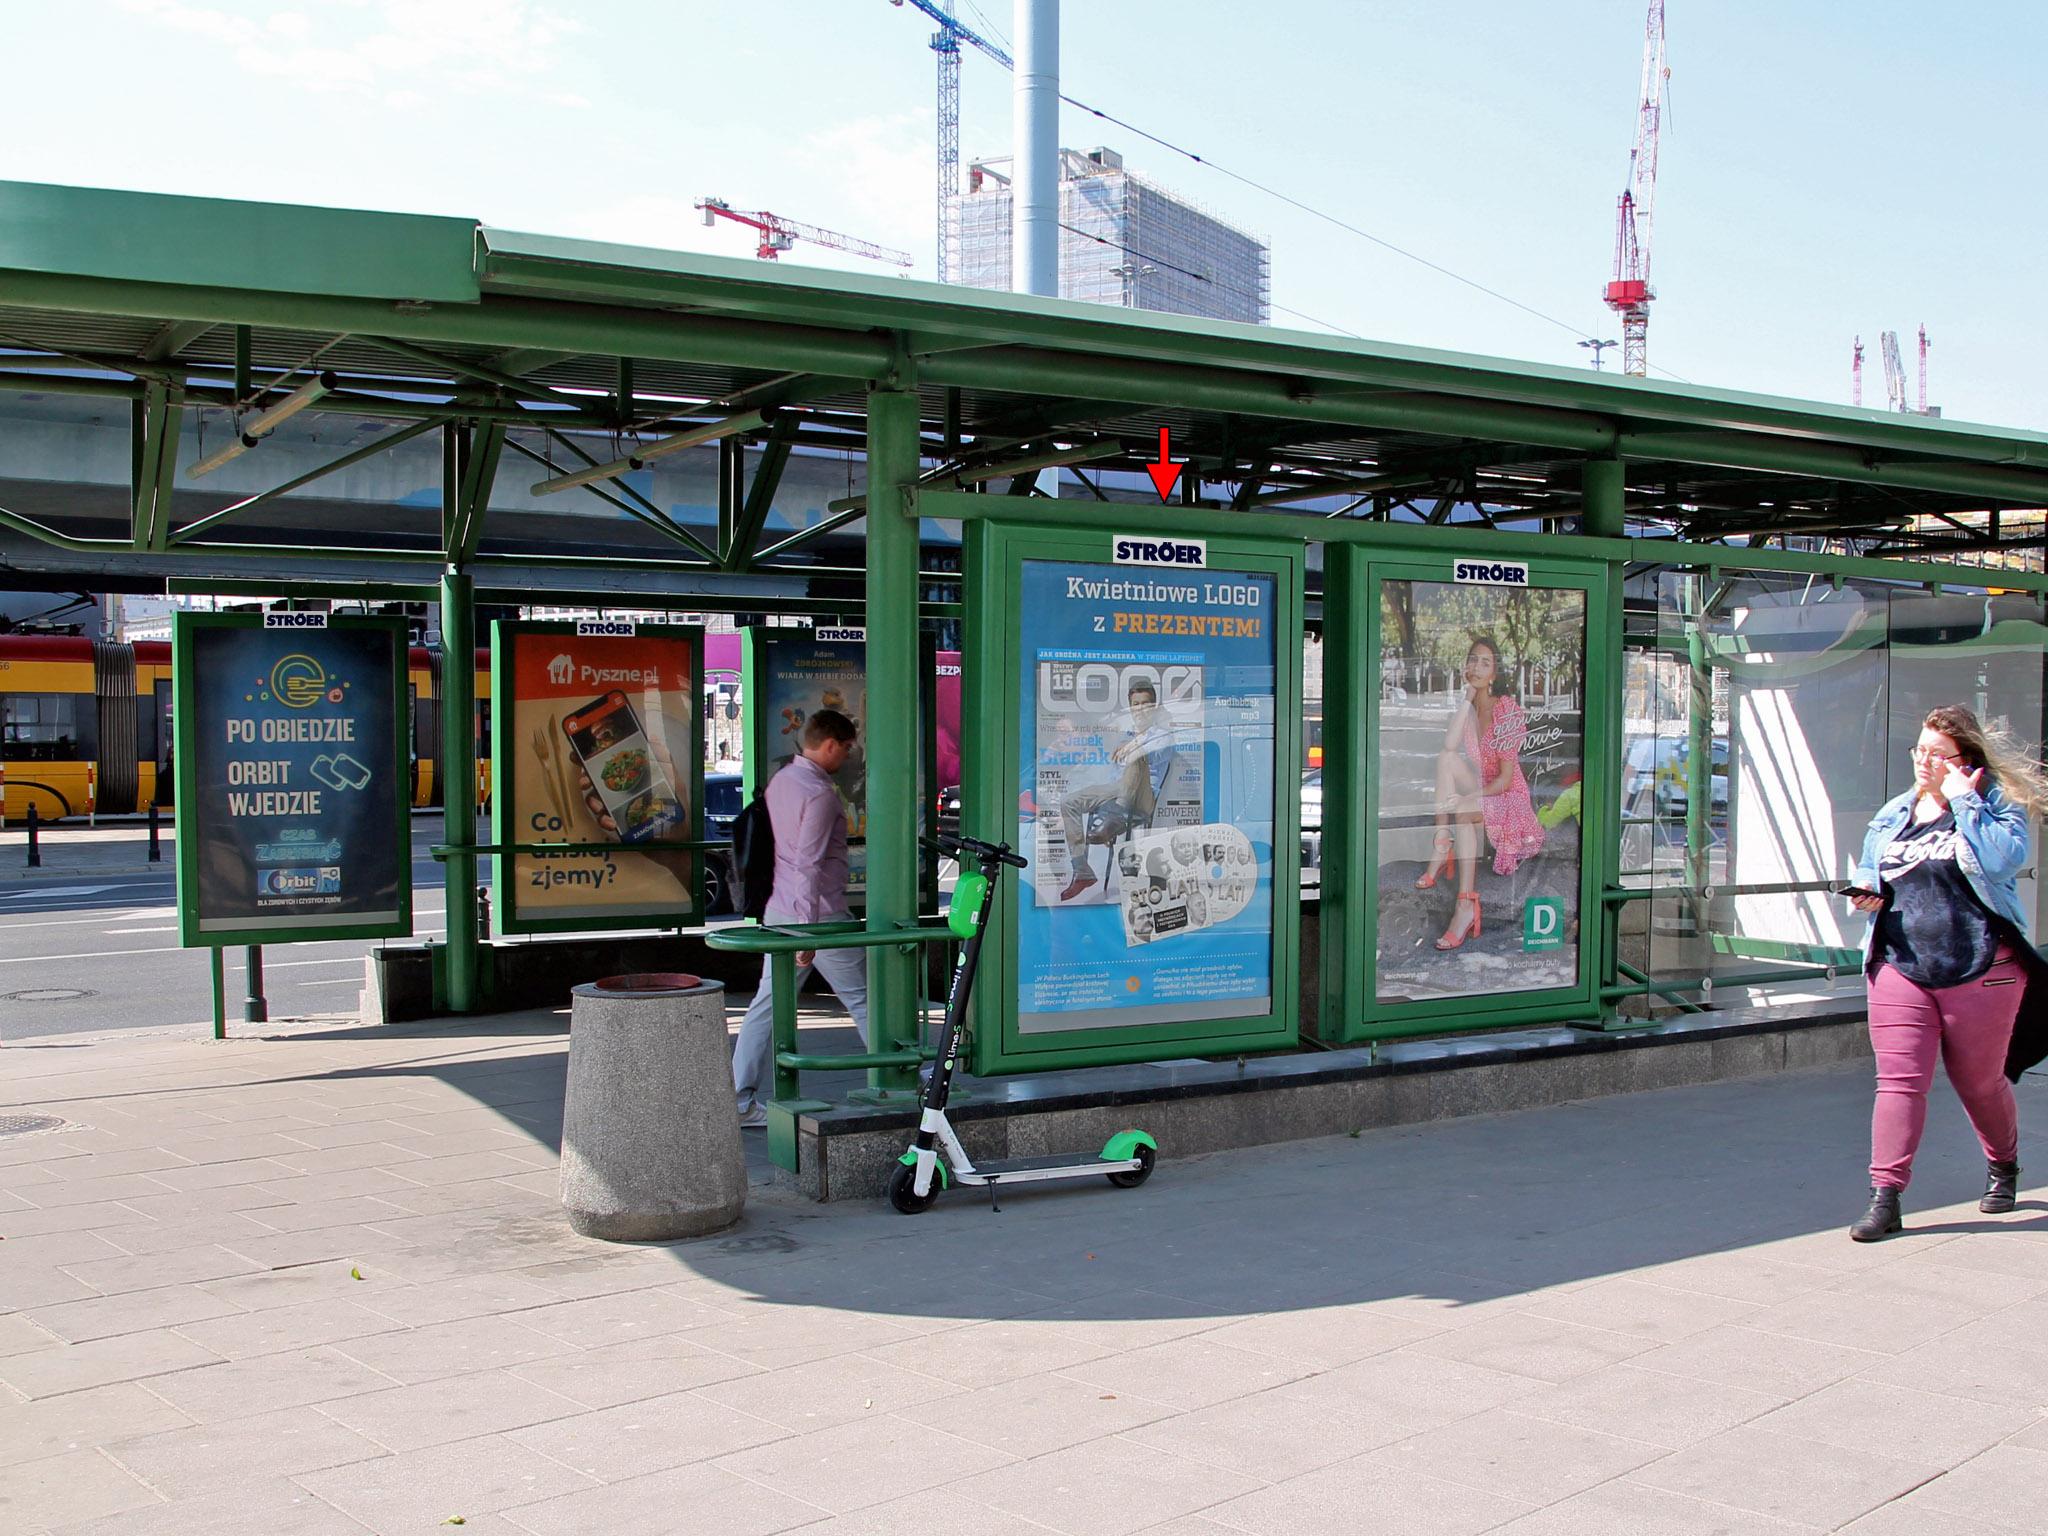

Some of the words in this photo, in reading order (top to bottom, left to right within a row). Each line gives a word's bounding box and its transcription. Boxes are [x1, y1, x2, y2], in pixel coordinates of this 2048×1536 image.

[1116, 541, 1203, 564] STRÖER
[1456, 563, 1526, 583] STRÖER
[1066, 576, 1198, 603] Kwietniowe
[1204, 583, 1260, 606] LOGO
[266, 613, 324, 626] STRÖER
[579, 622, 633, 635] STRÖER
[1113, 612, 1260, 638] PREZENTEM!
[818, 629, 864, 640] STRÖER
[581, 665, 658, 686] Pyszne.pl
[936, 665, 961, 676] BEZP
[1040, 662, 1203, 714] LOGO
[1053, 674, 1073, 690] 16
[1241, 711, 1260, 721] mp3
[227, 719, 256, 743] PO
[261, 718, 355, 742] OBIEDZIE
[1518, 727, 1563, 752] nowe
[228, 761, 291, 785] ORBIT
[1040, 770, 1062, 778] STYL
[228, 791, 321, 816] WJEDZIE
[1157, 807, 1200, 818] ROWERY
[531, 812, 562, 831] Co
[268, 869, 317, 894] Orbit
[531, 863, 617, 890] zjemy?
[1130, 885, 1162, 908] STO
[1533, 904, 1557, 935] D
[1527, 937, 1559, 945] DEICHMANN
